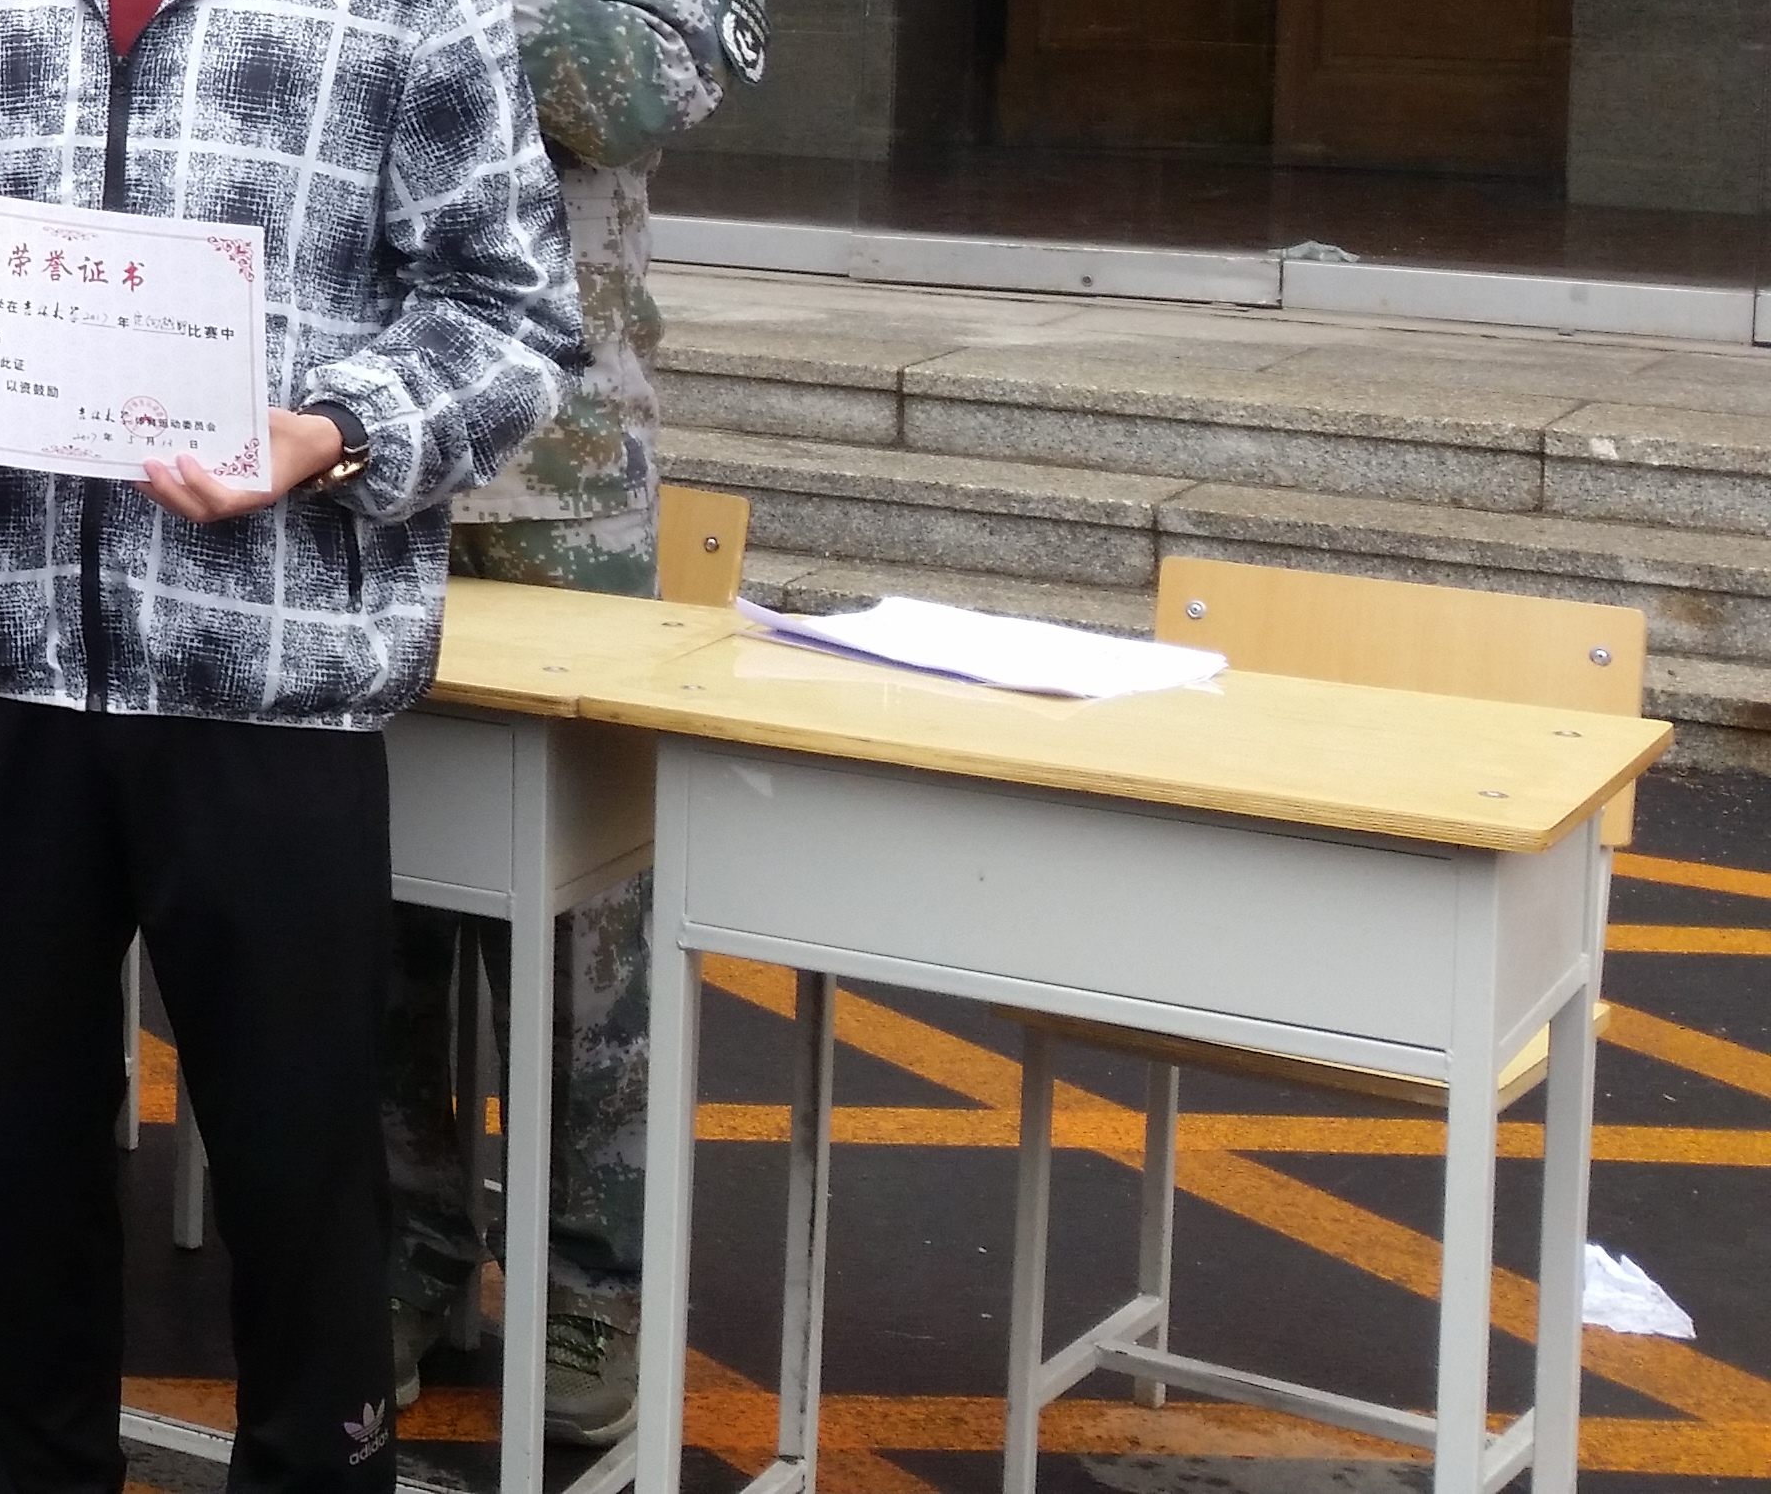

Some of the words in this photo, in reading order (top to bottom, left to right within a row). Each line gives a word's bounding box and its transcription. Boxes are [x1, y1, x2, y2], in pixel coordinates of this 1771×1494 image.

[6, 243, 146, 293] 荣誉证书
[6, 379, 60, 399] 以资鼓励
[348, 1429, 389, 1466] adidas
